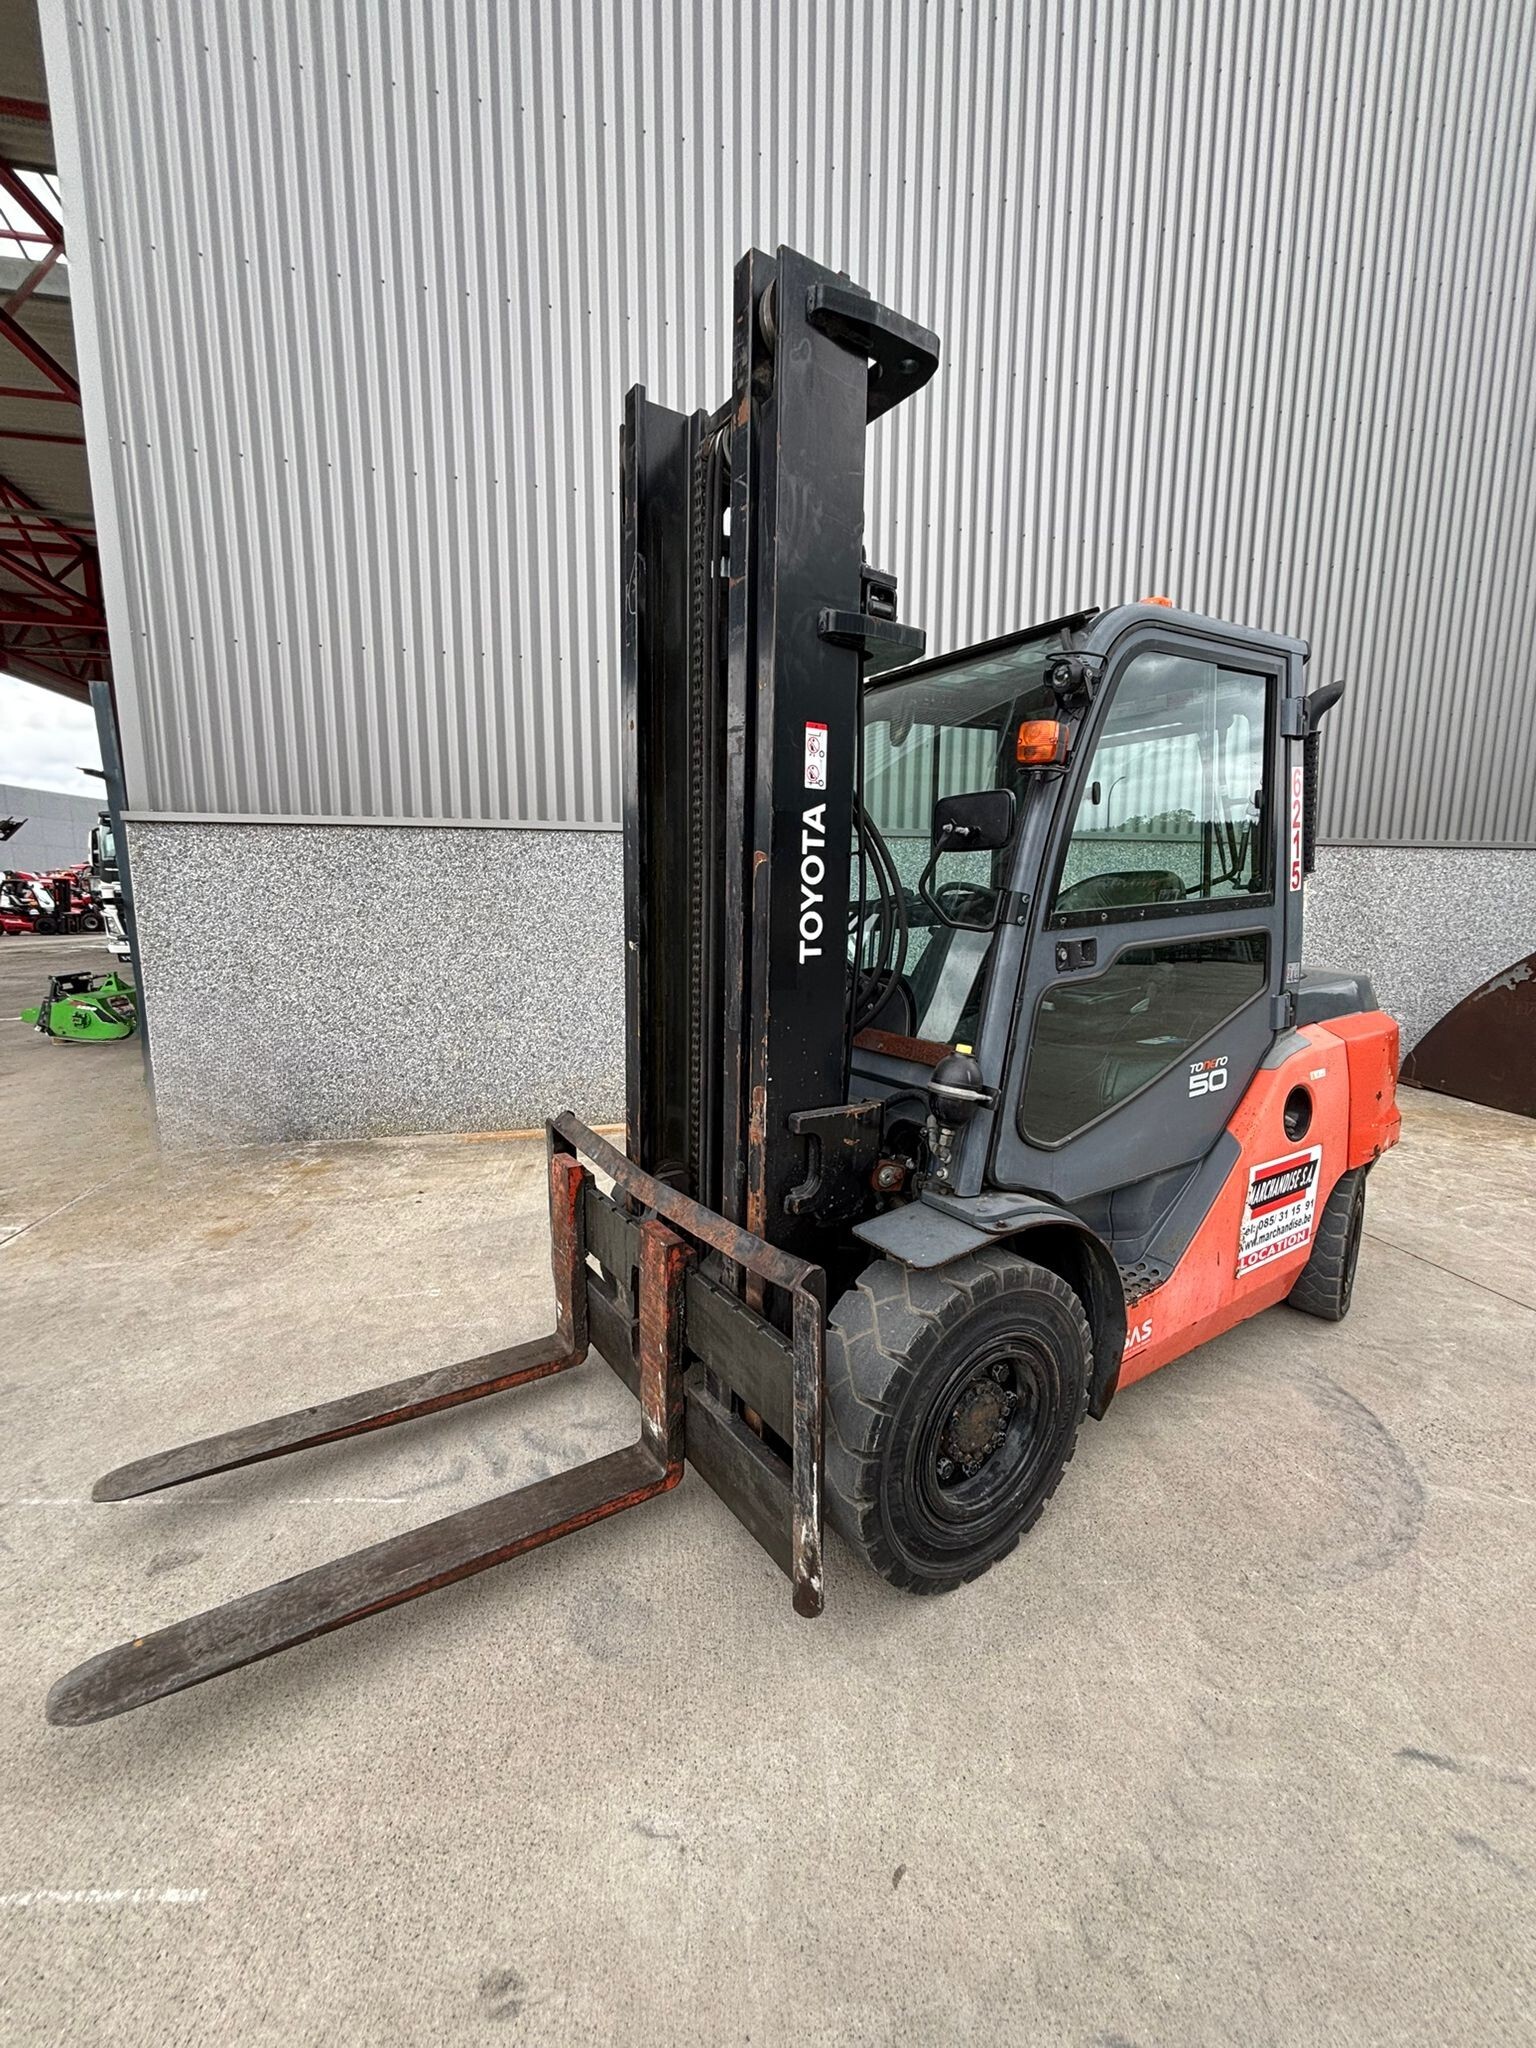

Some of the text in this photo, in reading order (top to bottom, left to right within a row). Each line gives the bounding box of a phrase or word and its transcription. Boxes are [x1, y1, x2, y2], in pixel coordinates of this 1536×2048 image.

[1291, 768, 1302, 890] 6215
[799, 803, 827, 965] TOYOTA
[1189, 1067, 1228, 1098] 50
[1278, 1209, 1288, 1222] 31
[1291, 1203, 1301, 1216] 15
[1305, 1198, 1314, 1211] 91
[1239, 1229, 1306, 1269] LOCATION
